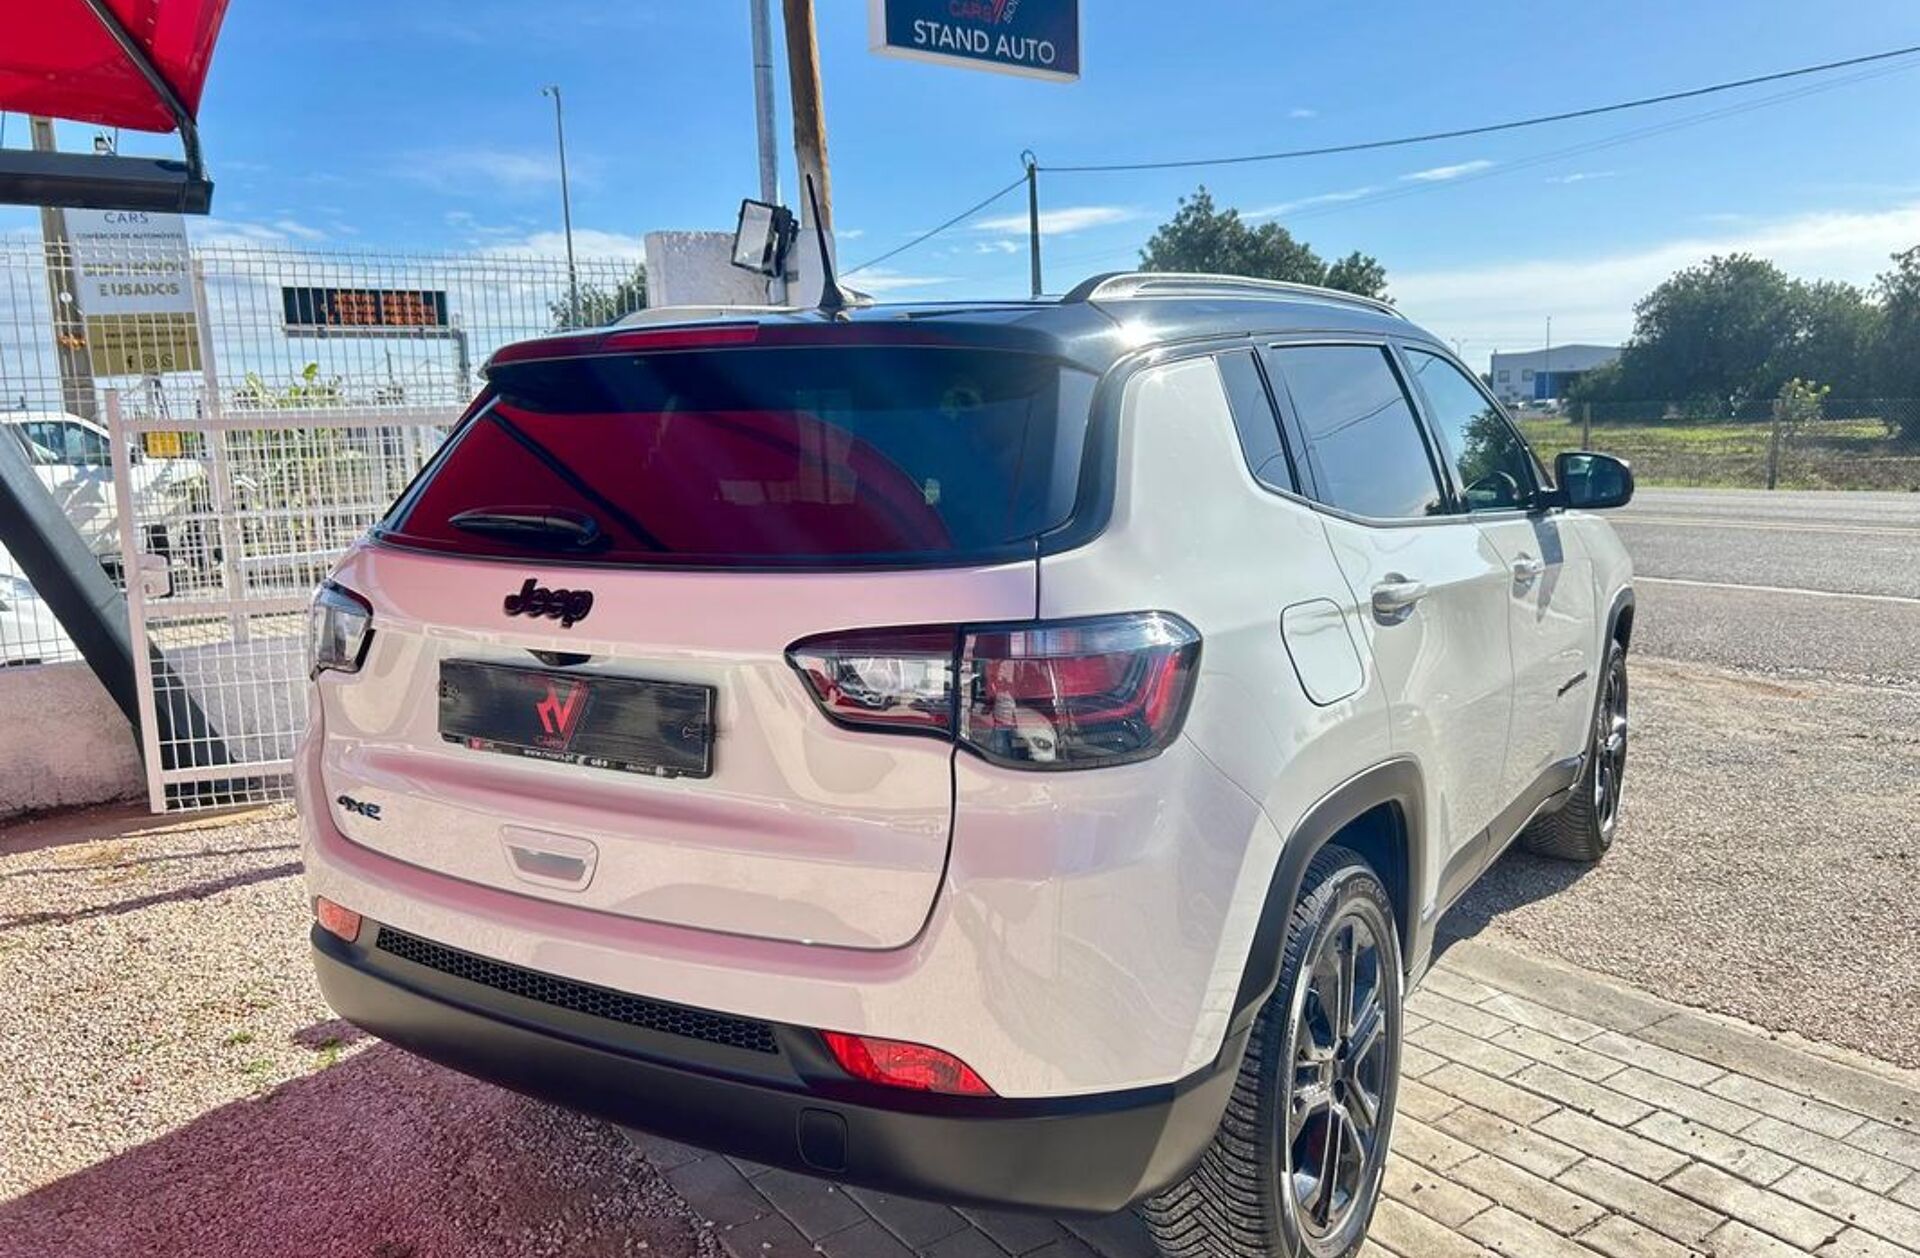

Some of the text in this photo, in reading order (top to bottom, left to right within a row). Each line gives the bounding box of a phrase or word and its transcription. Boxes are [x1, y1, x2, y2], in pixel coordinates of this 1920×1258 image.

[914, 19, 1056, 64] STAND AUTO
[103, 211, 149, 224] CARS
[100, 283, 180, 296] E USADOS
[504, 578, 593, 629] Jeep
